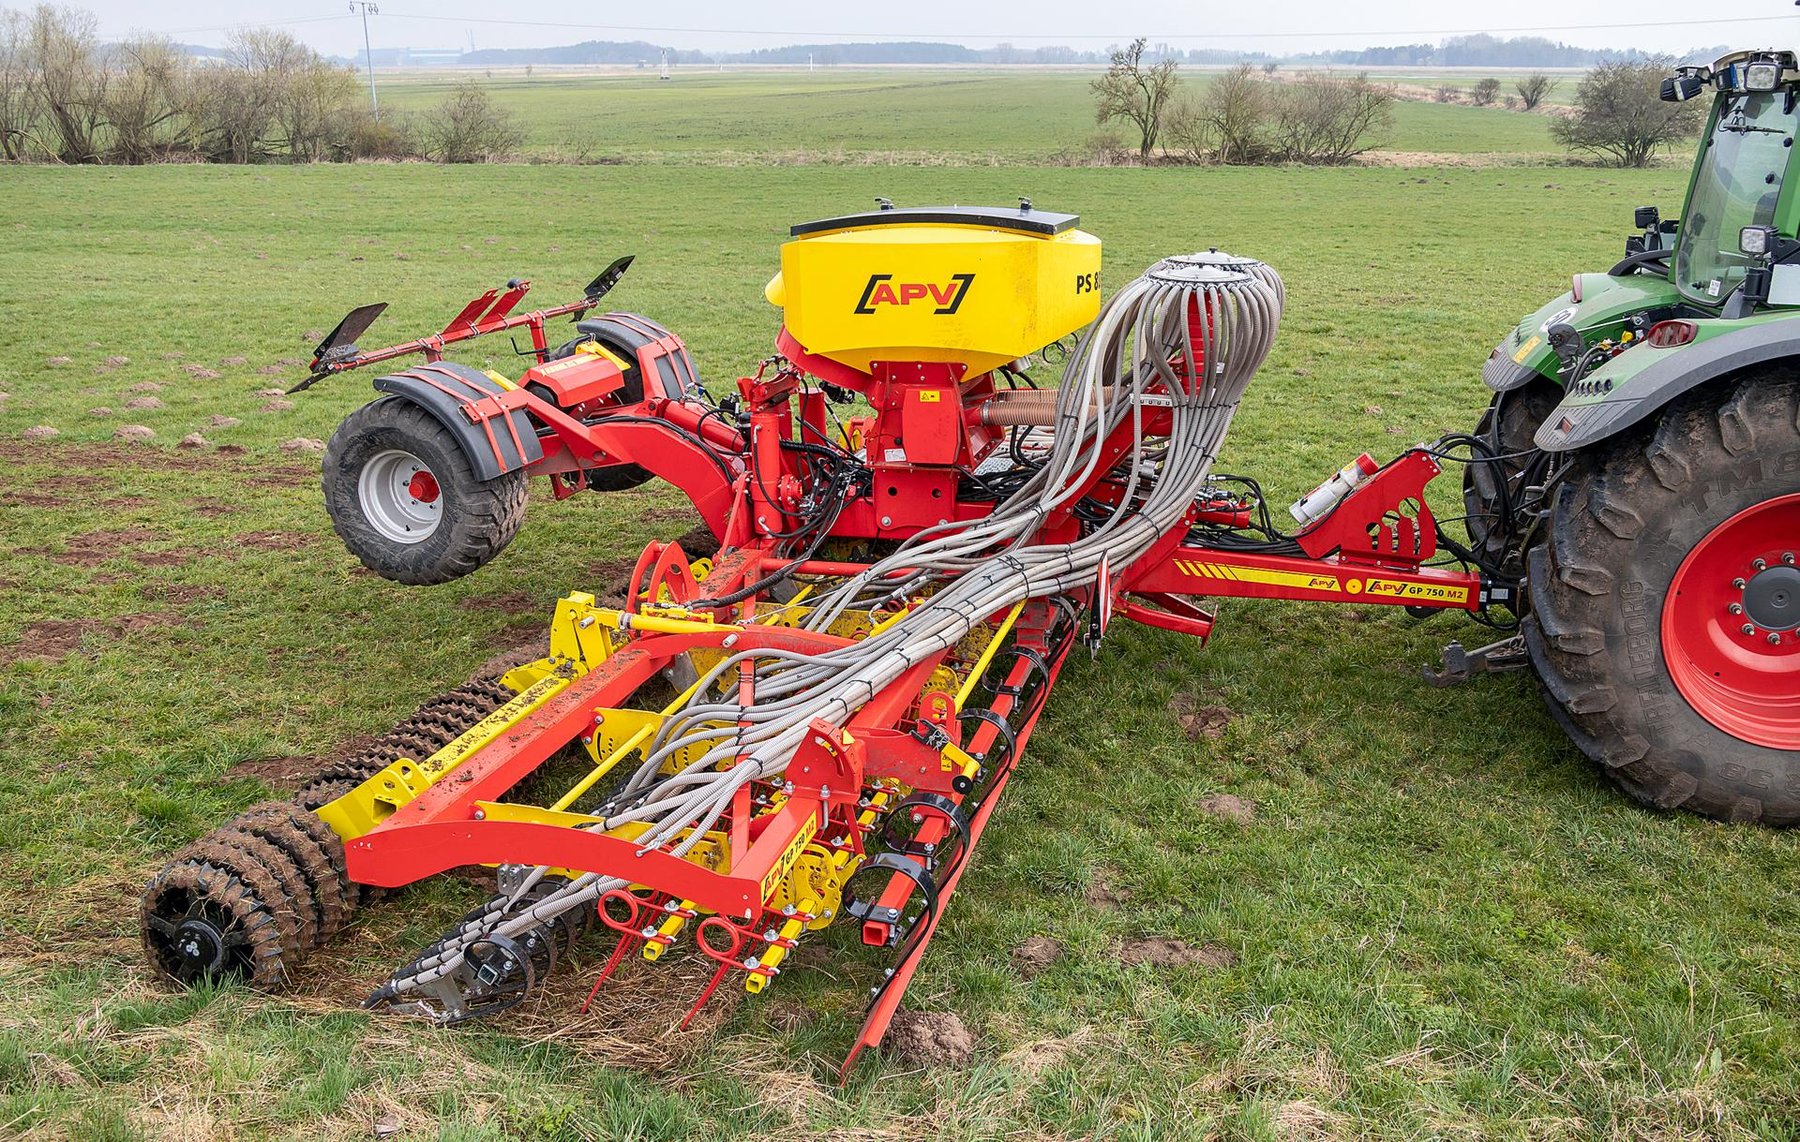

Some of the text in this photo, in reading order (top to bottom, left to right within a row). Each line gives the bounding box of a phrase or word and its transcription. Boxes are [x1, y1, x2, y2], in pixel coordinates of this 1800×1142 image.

[1076, 271, 1101, 295] PS 8
[1409, 587, 1423, 595] GP
[1426, 588, 1444, 597] 750
[1447, 590, 1463, 599] M2
[785, 848, 794, 865] GP
[795, 832, 806, 853] 750
[806, 819, 815, 838] M2
